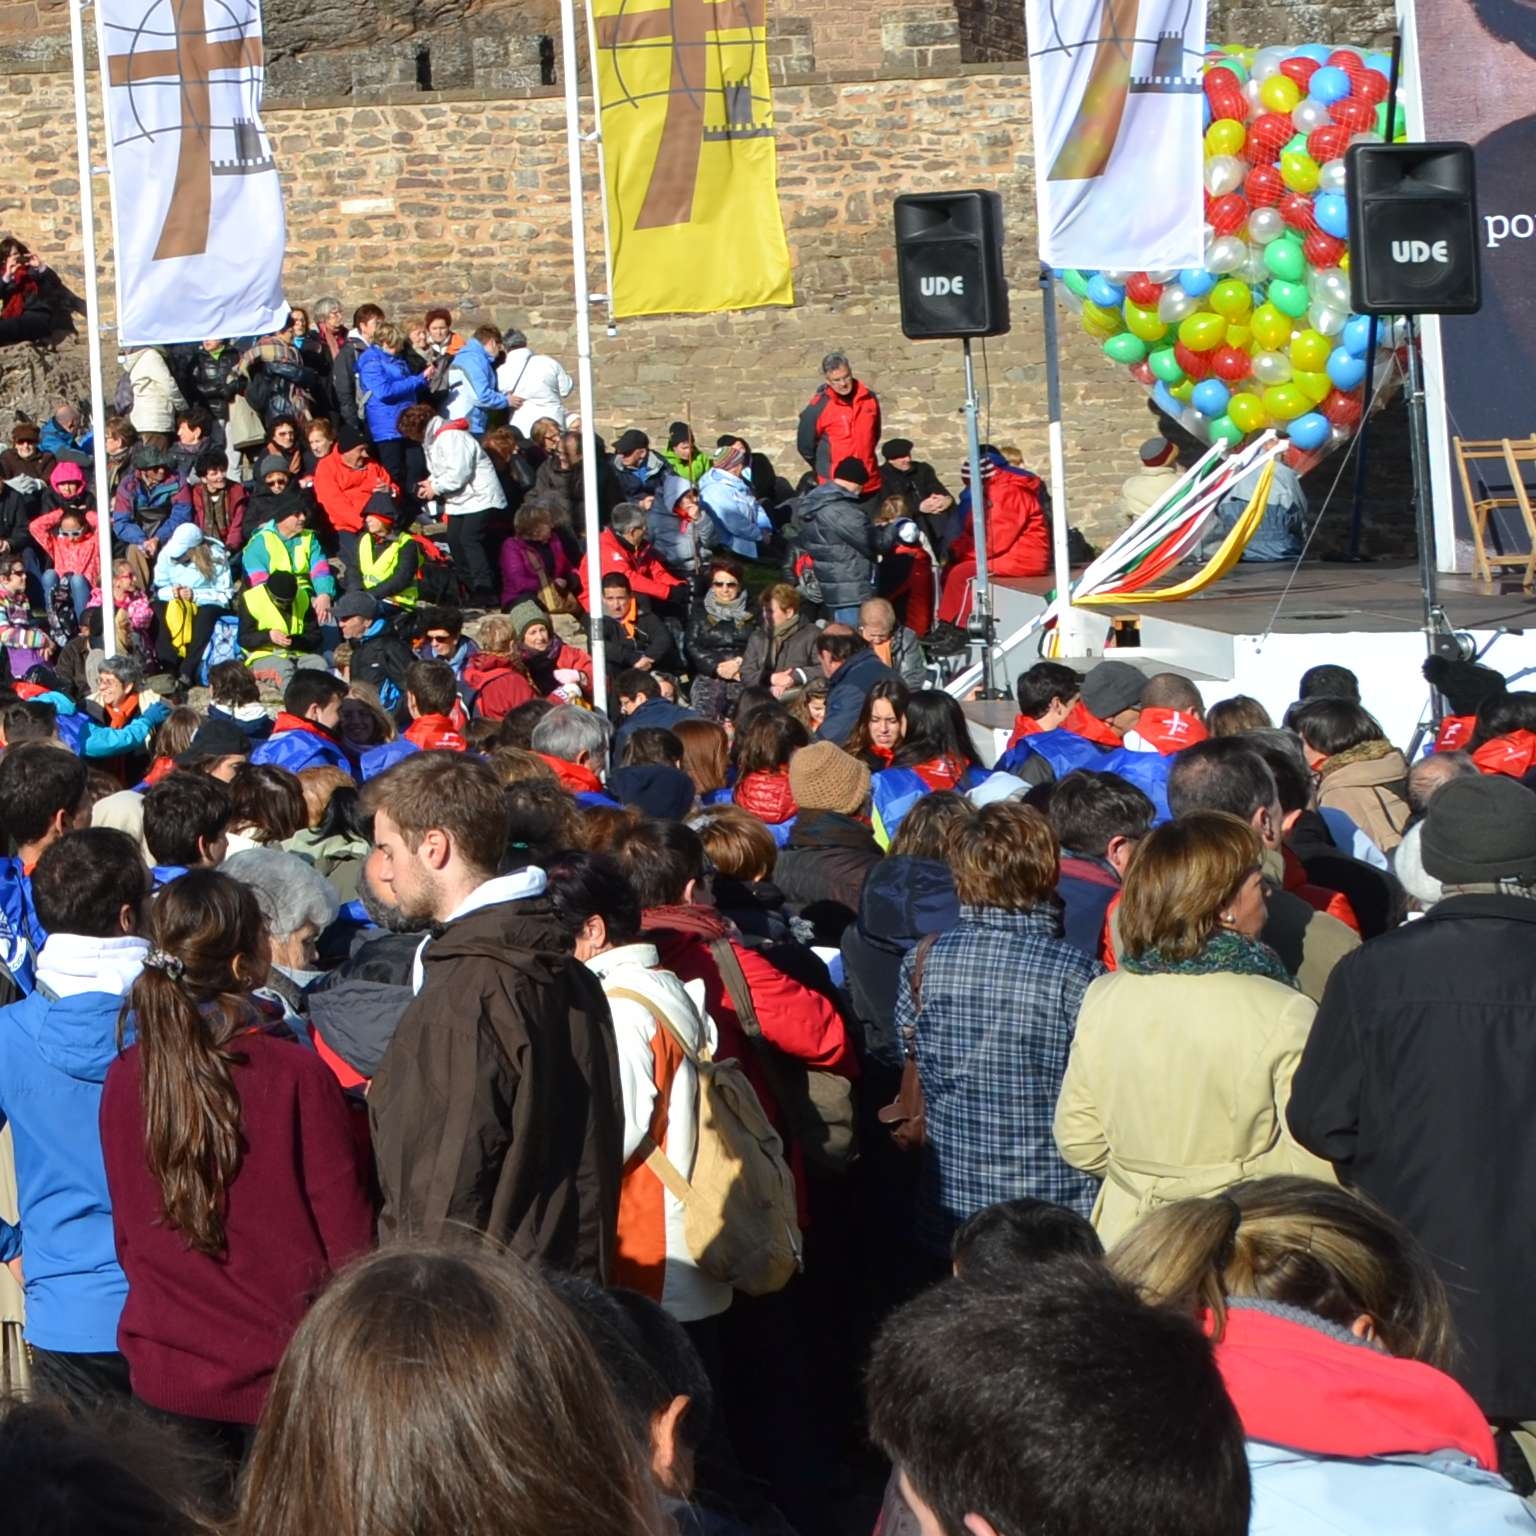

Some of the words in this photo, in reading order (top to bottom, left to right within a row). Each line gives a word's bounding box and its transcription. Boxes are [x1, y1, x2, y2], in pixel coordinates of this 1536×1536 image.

[1484, 214, 1536, 248] po
[1392, 240, 1449, 263] UDE
[920, 275, 964, 296] UDE
